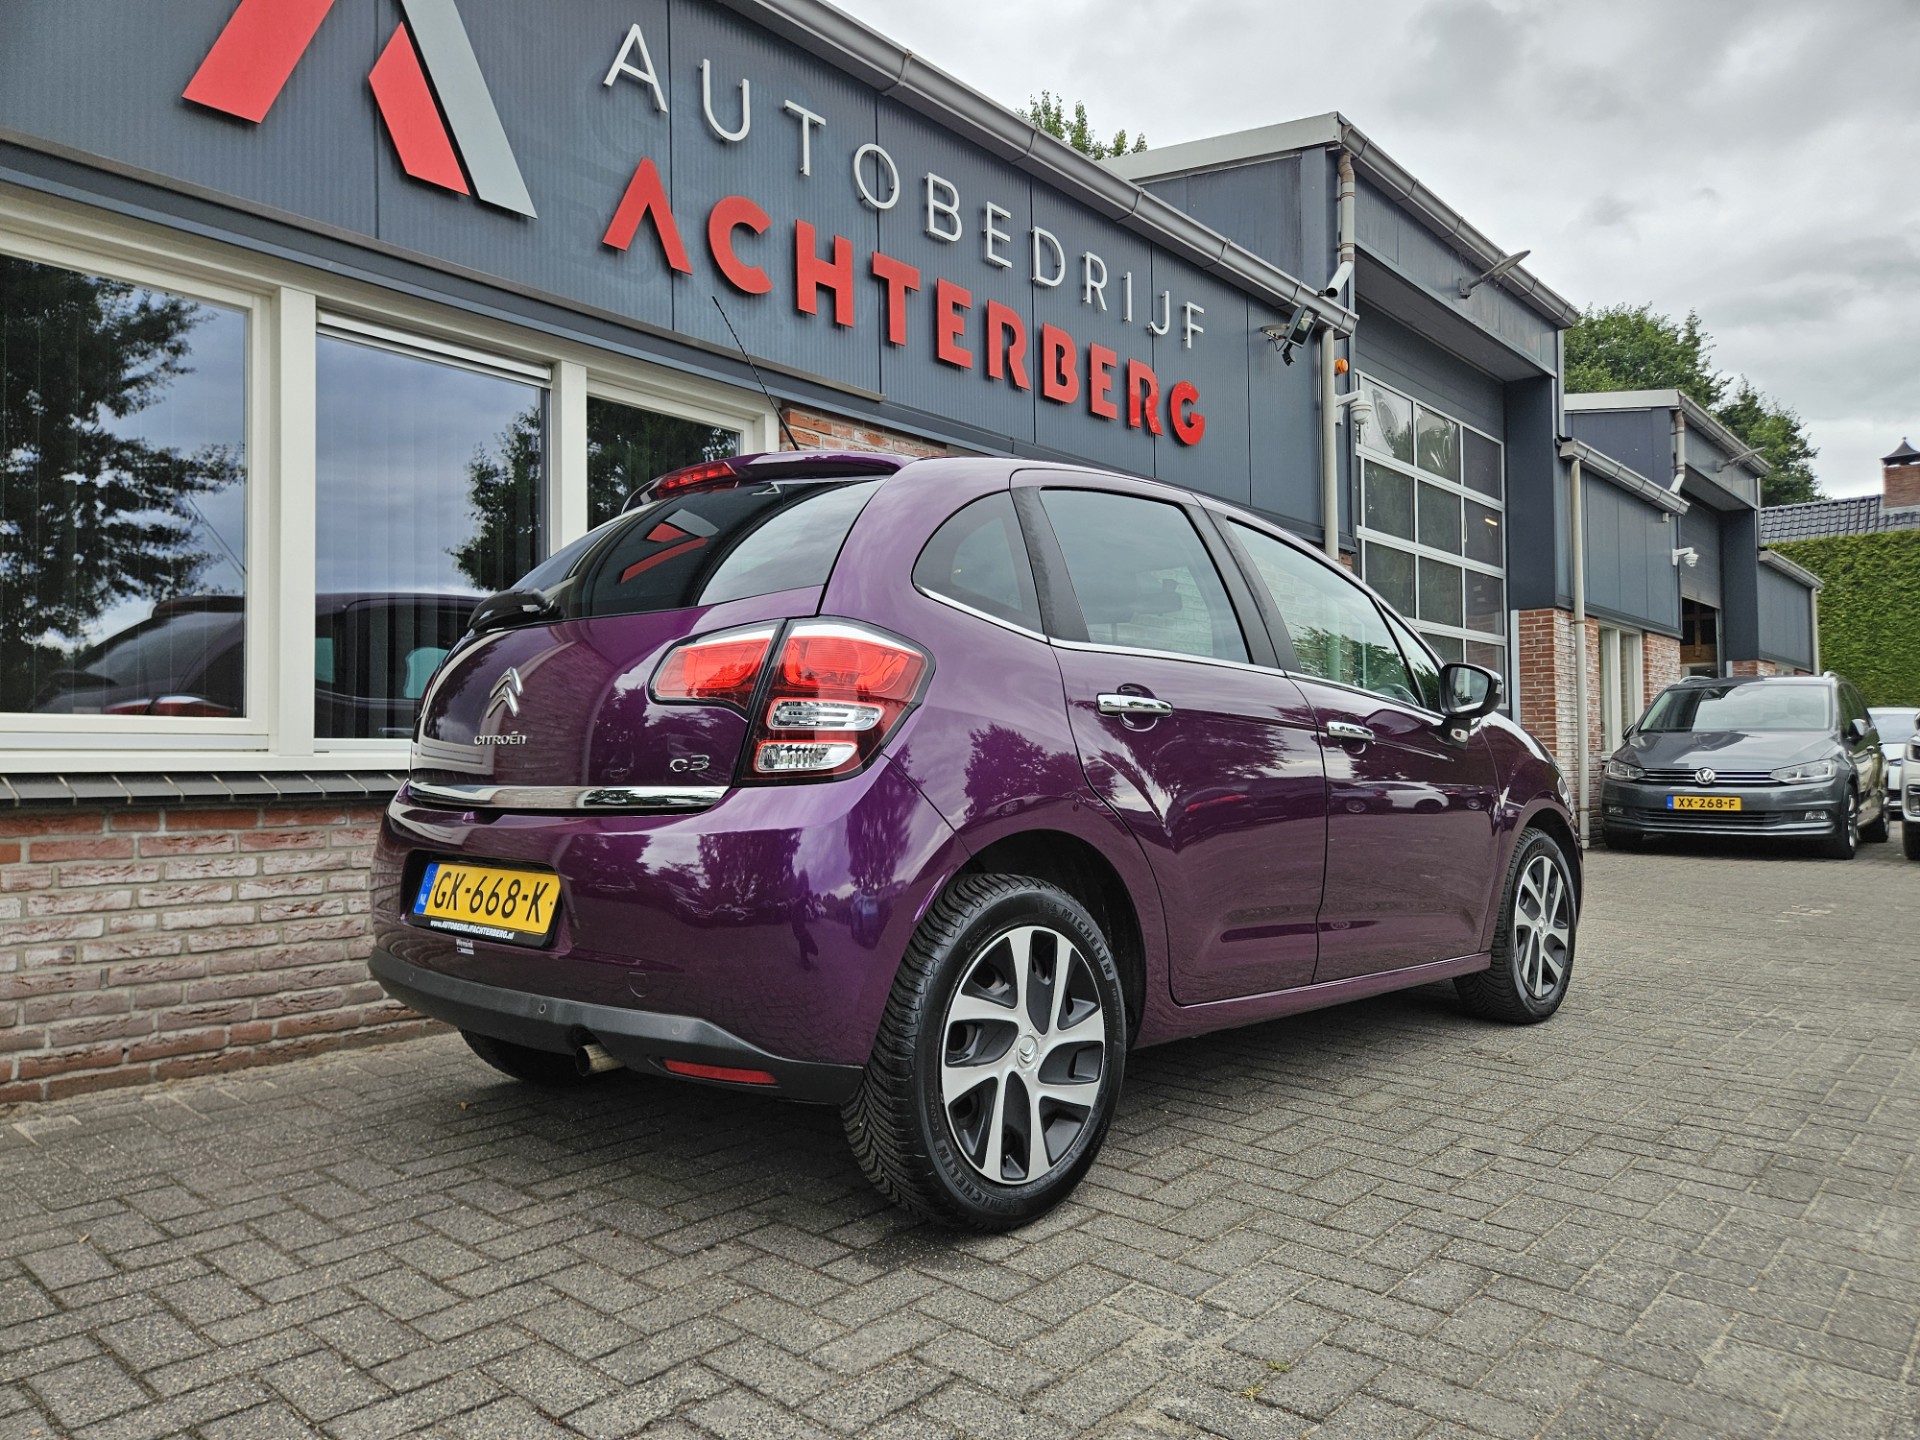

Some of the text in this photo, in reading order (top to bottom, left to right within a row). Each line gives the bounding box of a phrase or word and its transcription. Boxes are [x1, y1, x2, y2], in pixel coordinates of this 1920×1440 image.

[603, 23, 1205, 349] AUTOBEDRIJF
[602, 157, 1206, 447] ACHTERBERG
[474, 731, 527, 745] CITROËN
[669, 754, 710, 773] C3
[1678, 797, 1736, 809] XX-268-F
[434, 871, 550, 924] GK-668-K
[1061, 908, 1114, 976] MICHELIN
